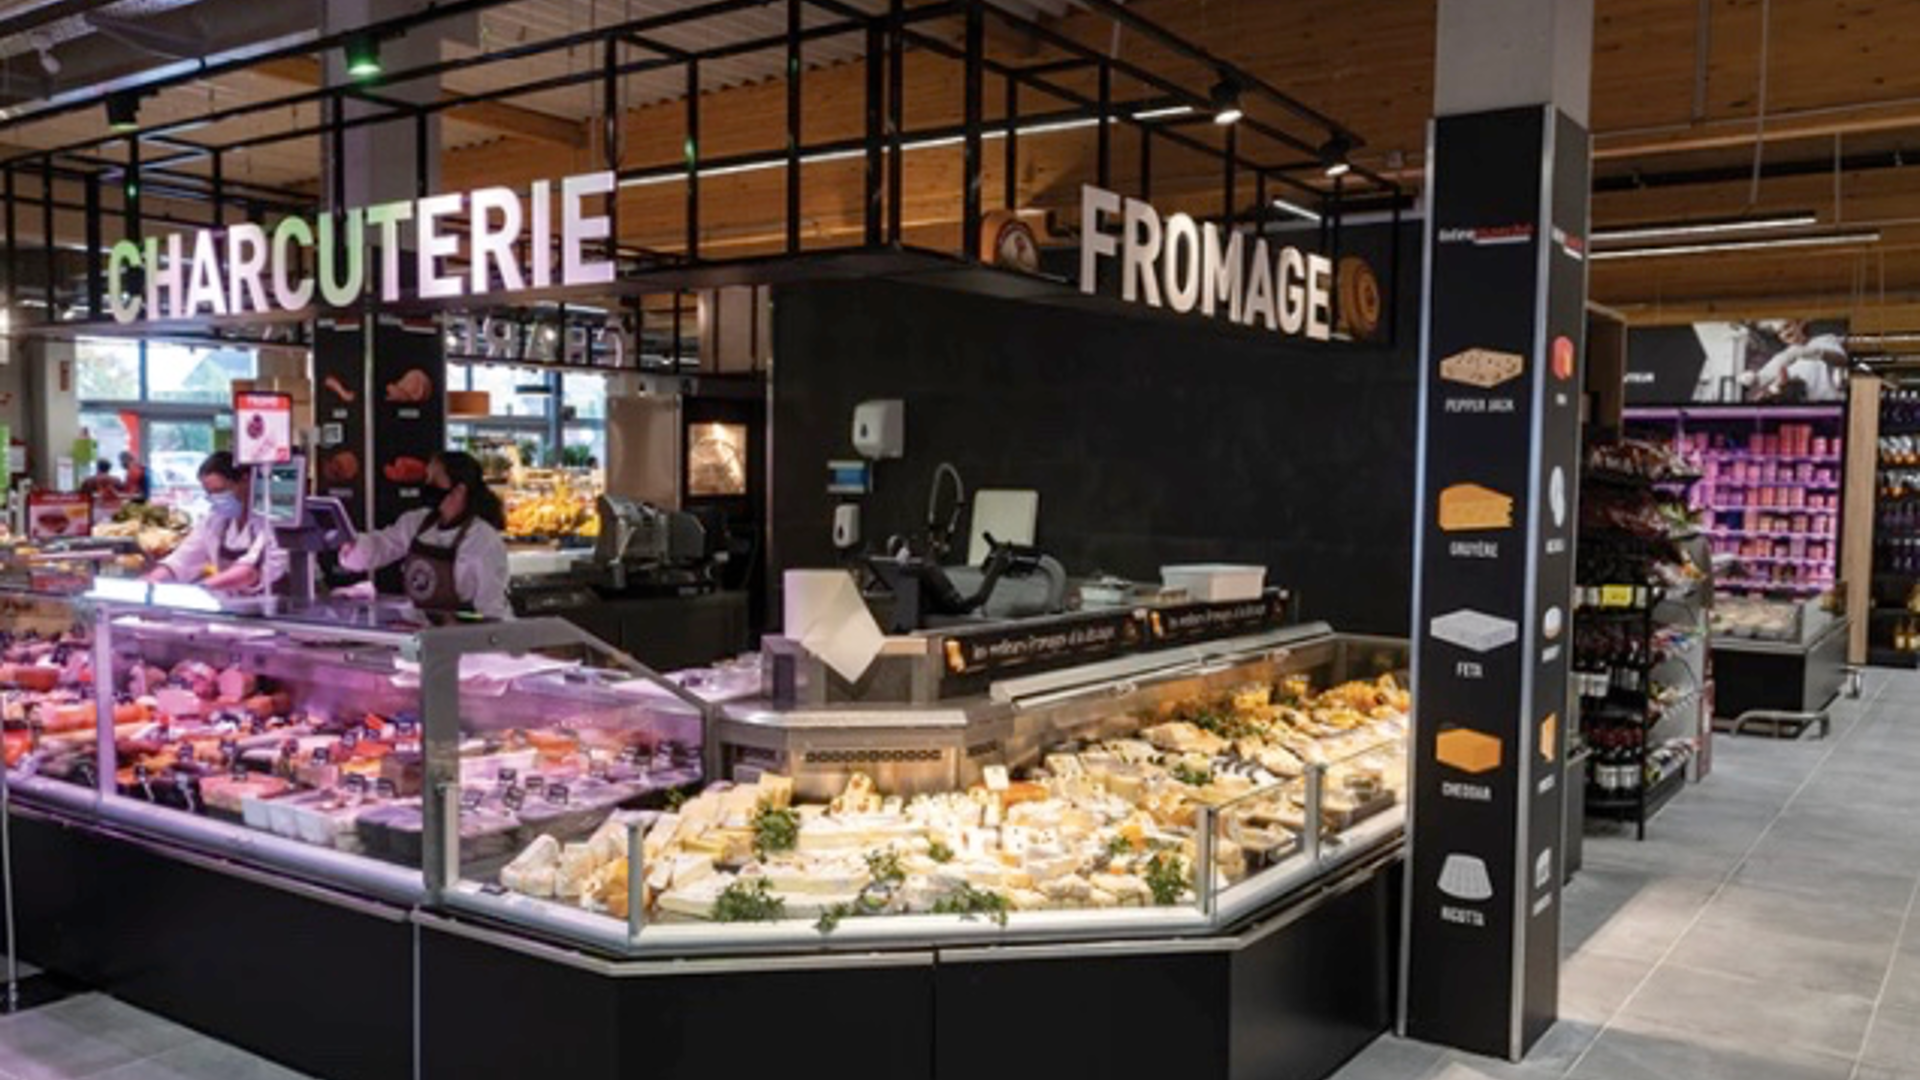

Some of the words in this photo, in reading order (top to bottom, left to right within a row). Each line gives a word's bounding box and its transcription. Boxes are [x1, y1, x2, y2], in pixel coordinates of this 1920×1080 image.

[108, 170, 616, 324] CHARCUTERIE
[1080, 184, 1332, 341] FROMAGE
[1445, 398, 1486, 413] PEPPER
[1487, 399, 1514, 412] JACK
[1456, 661, 1484, 679] FETA
[1441, 781, 1493, 802] CHEDDAR
[1441, 905, 1486, 927] RICOTTA
